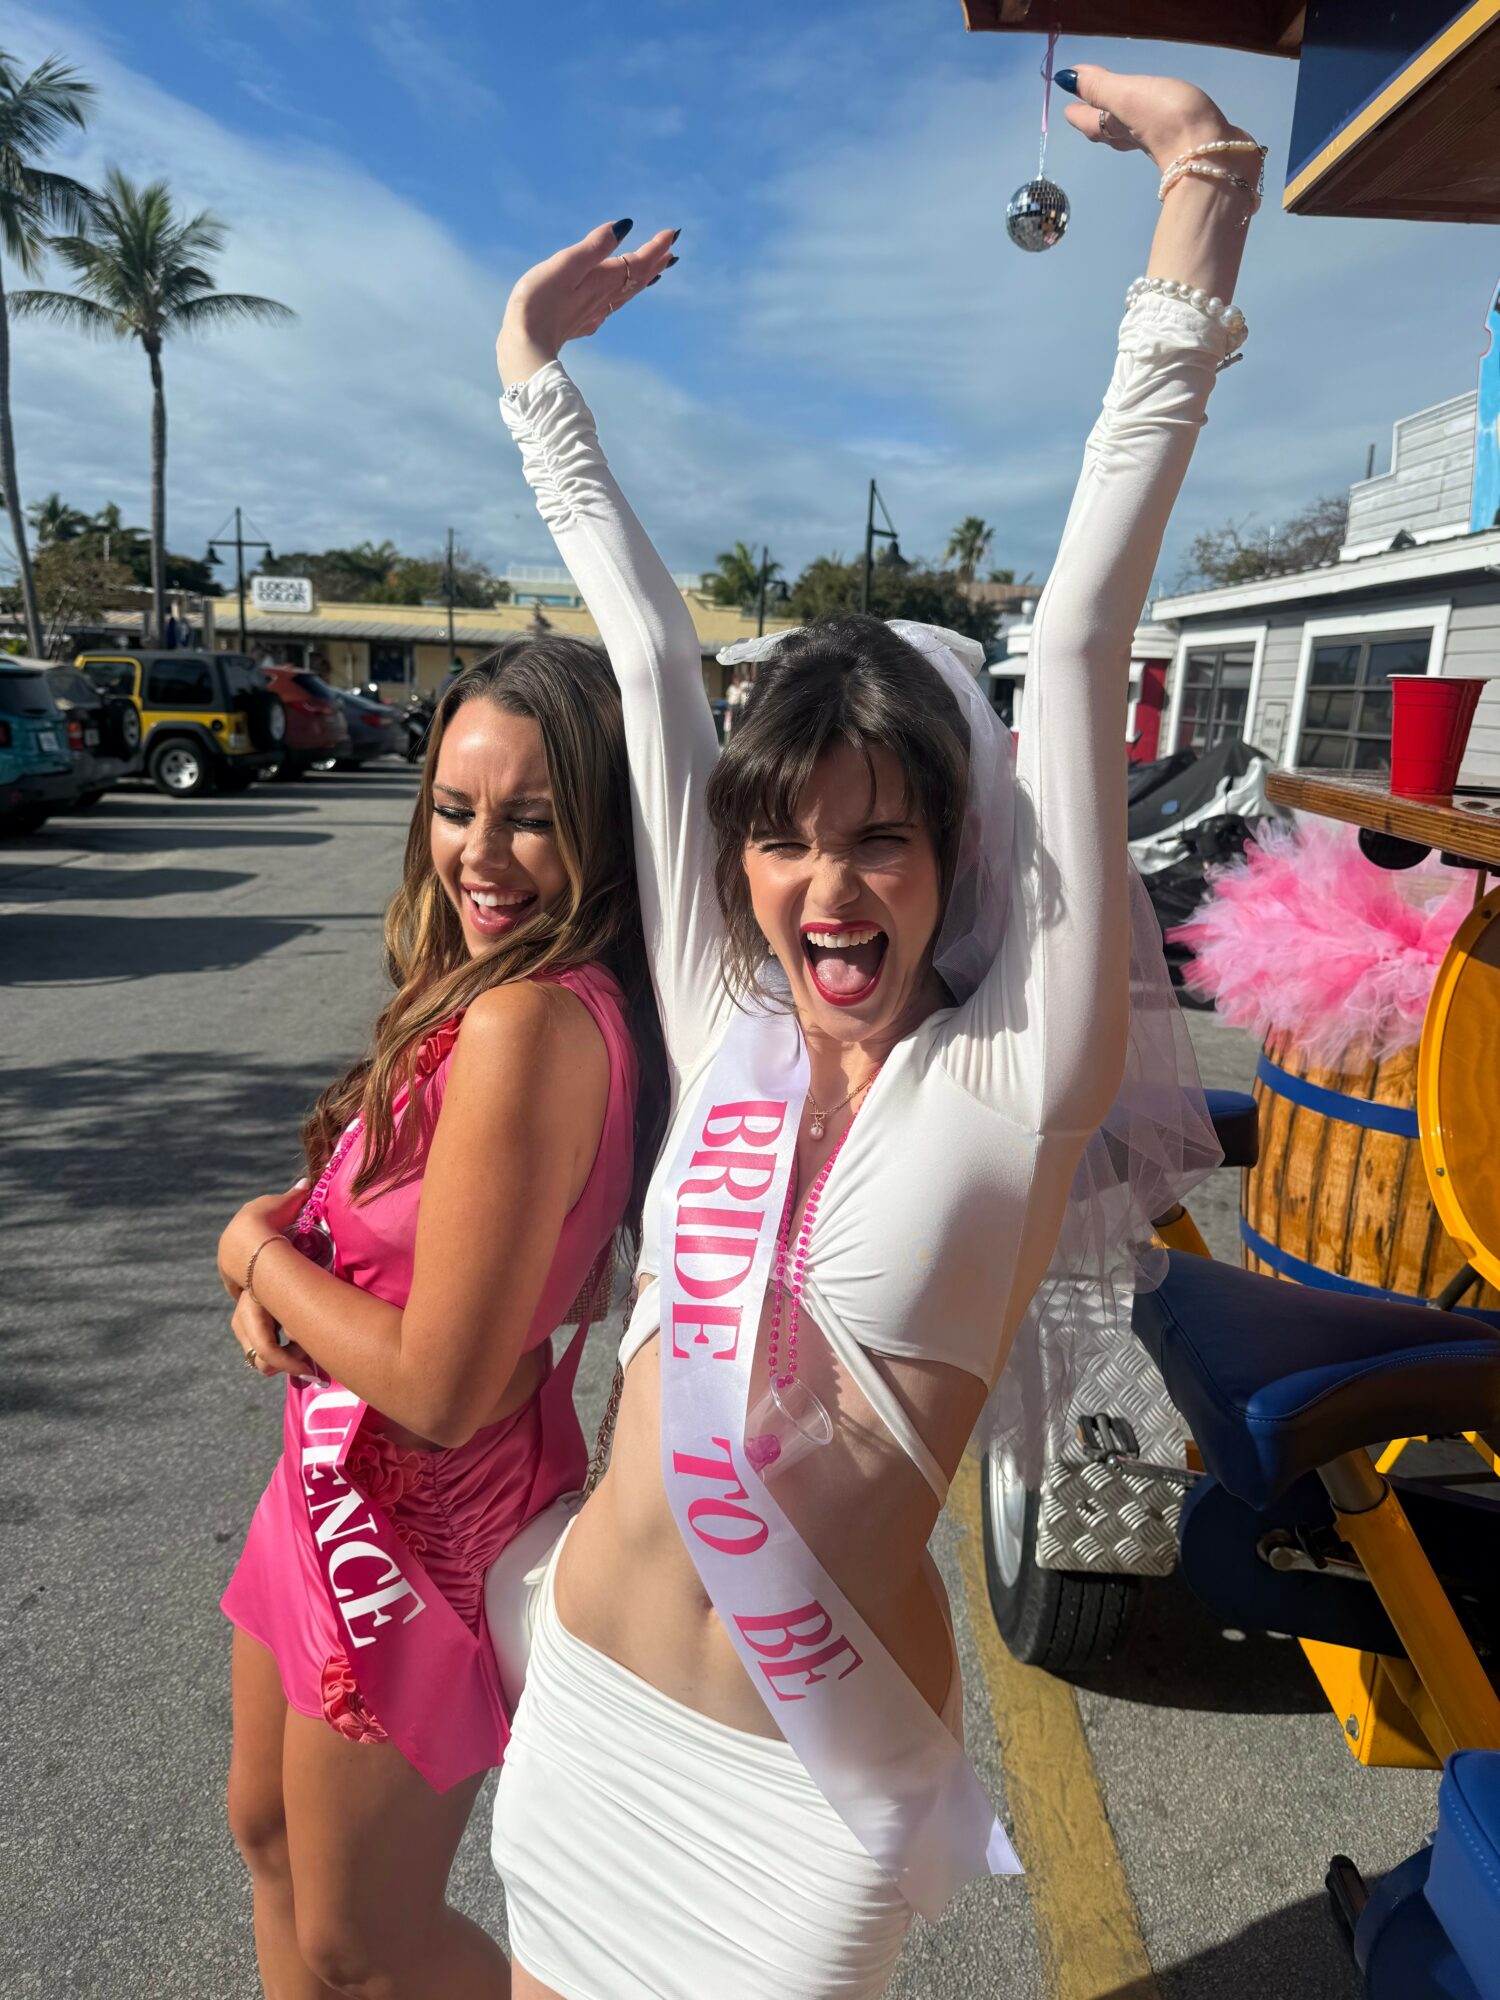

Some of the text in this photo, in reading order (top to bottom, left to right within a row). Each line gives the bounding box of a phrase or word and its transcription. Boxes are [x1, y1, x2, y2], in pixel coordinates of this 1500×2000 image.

[258, 581, 306, 593] LOCAL
[258, 592, 306, 603] COLOR
[672, 1100, 863, 1701] BRIDE TO BE
[302, 1391, 427, 1649] UENCE
